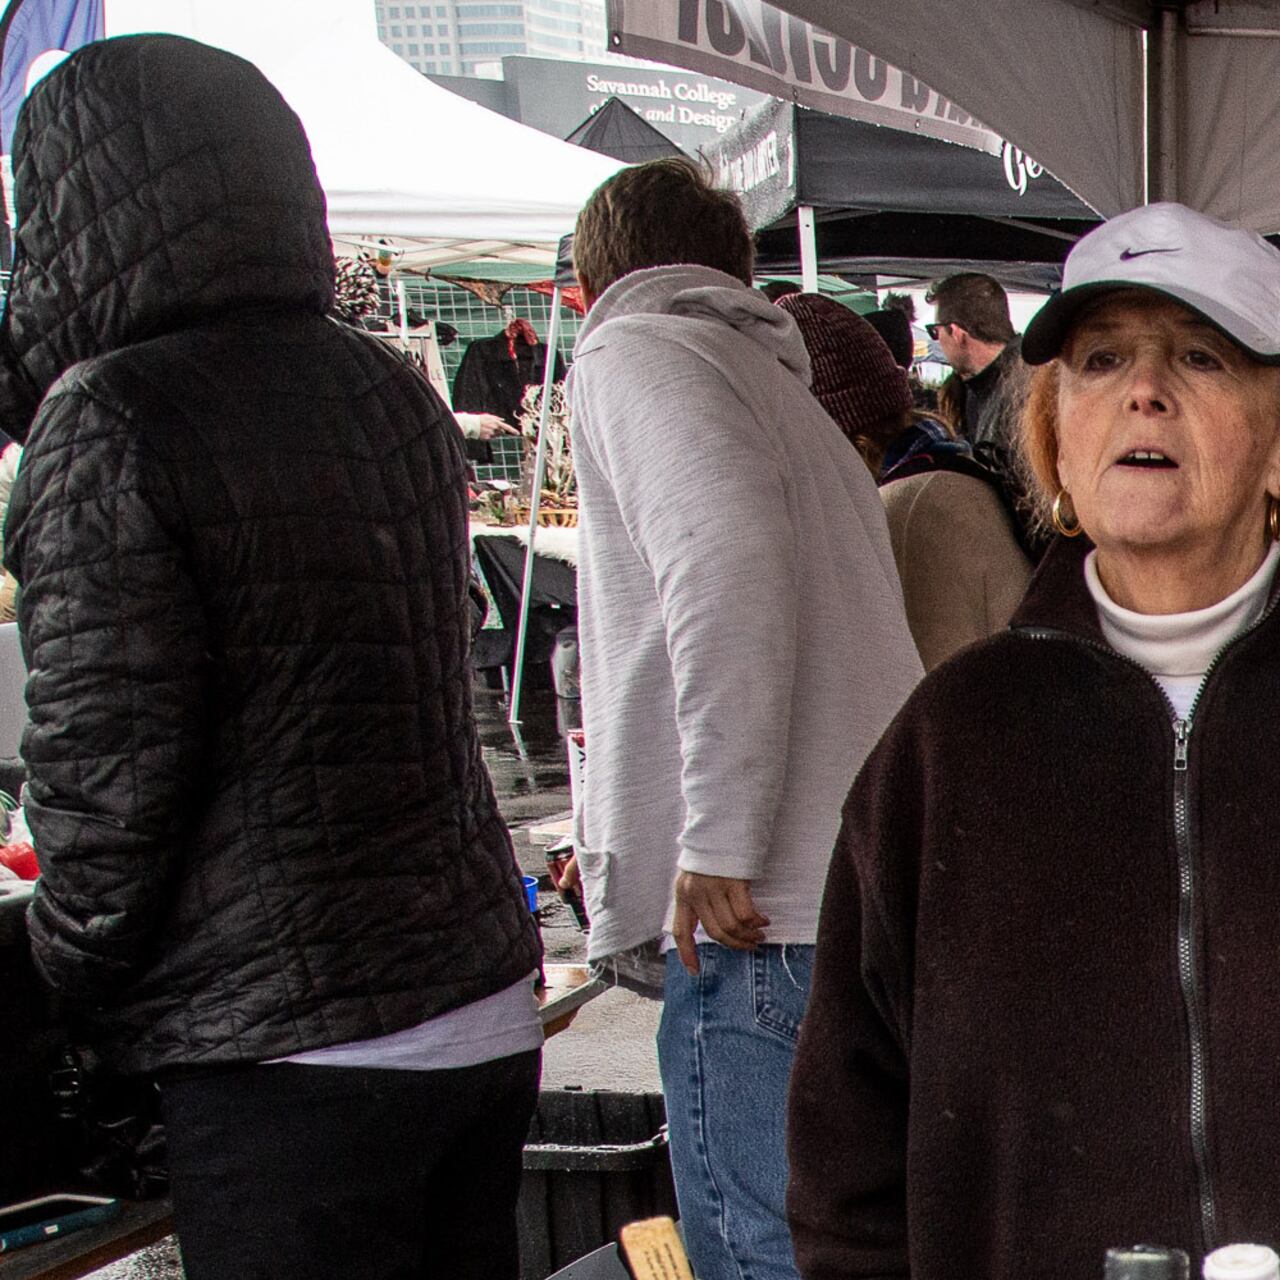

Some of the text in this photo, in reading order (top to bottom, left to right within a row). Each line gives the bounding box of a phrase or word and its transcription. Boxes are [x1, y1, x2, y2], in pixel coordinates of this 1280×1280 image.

[587, 74, 737, 109] Savannah College
[646, 104, 674, 123] and
